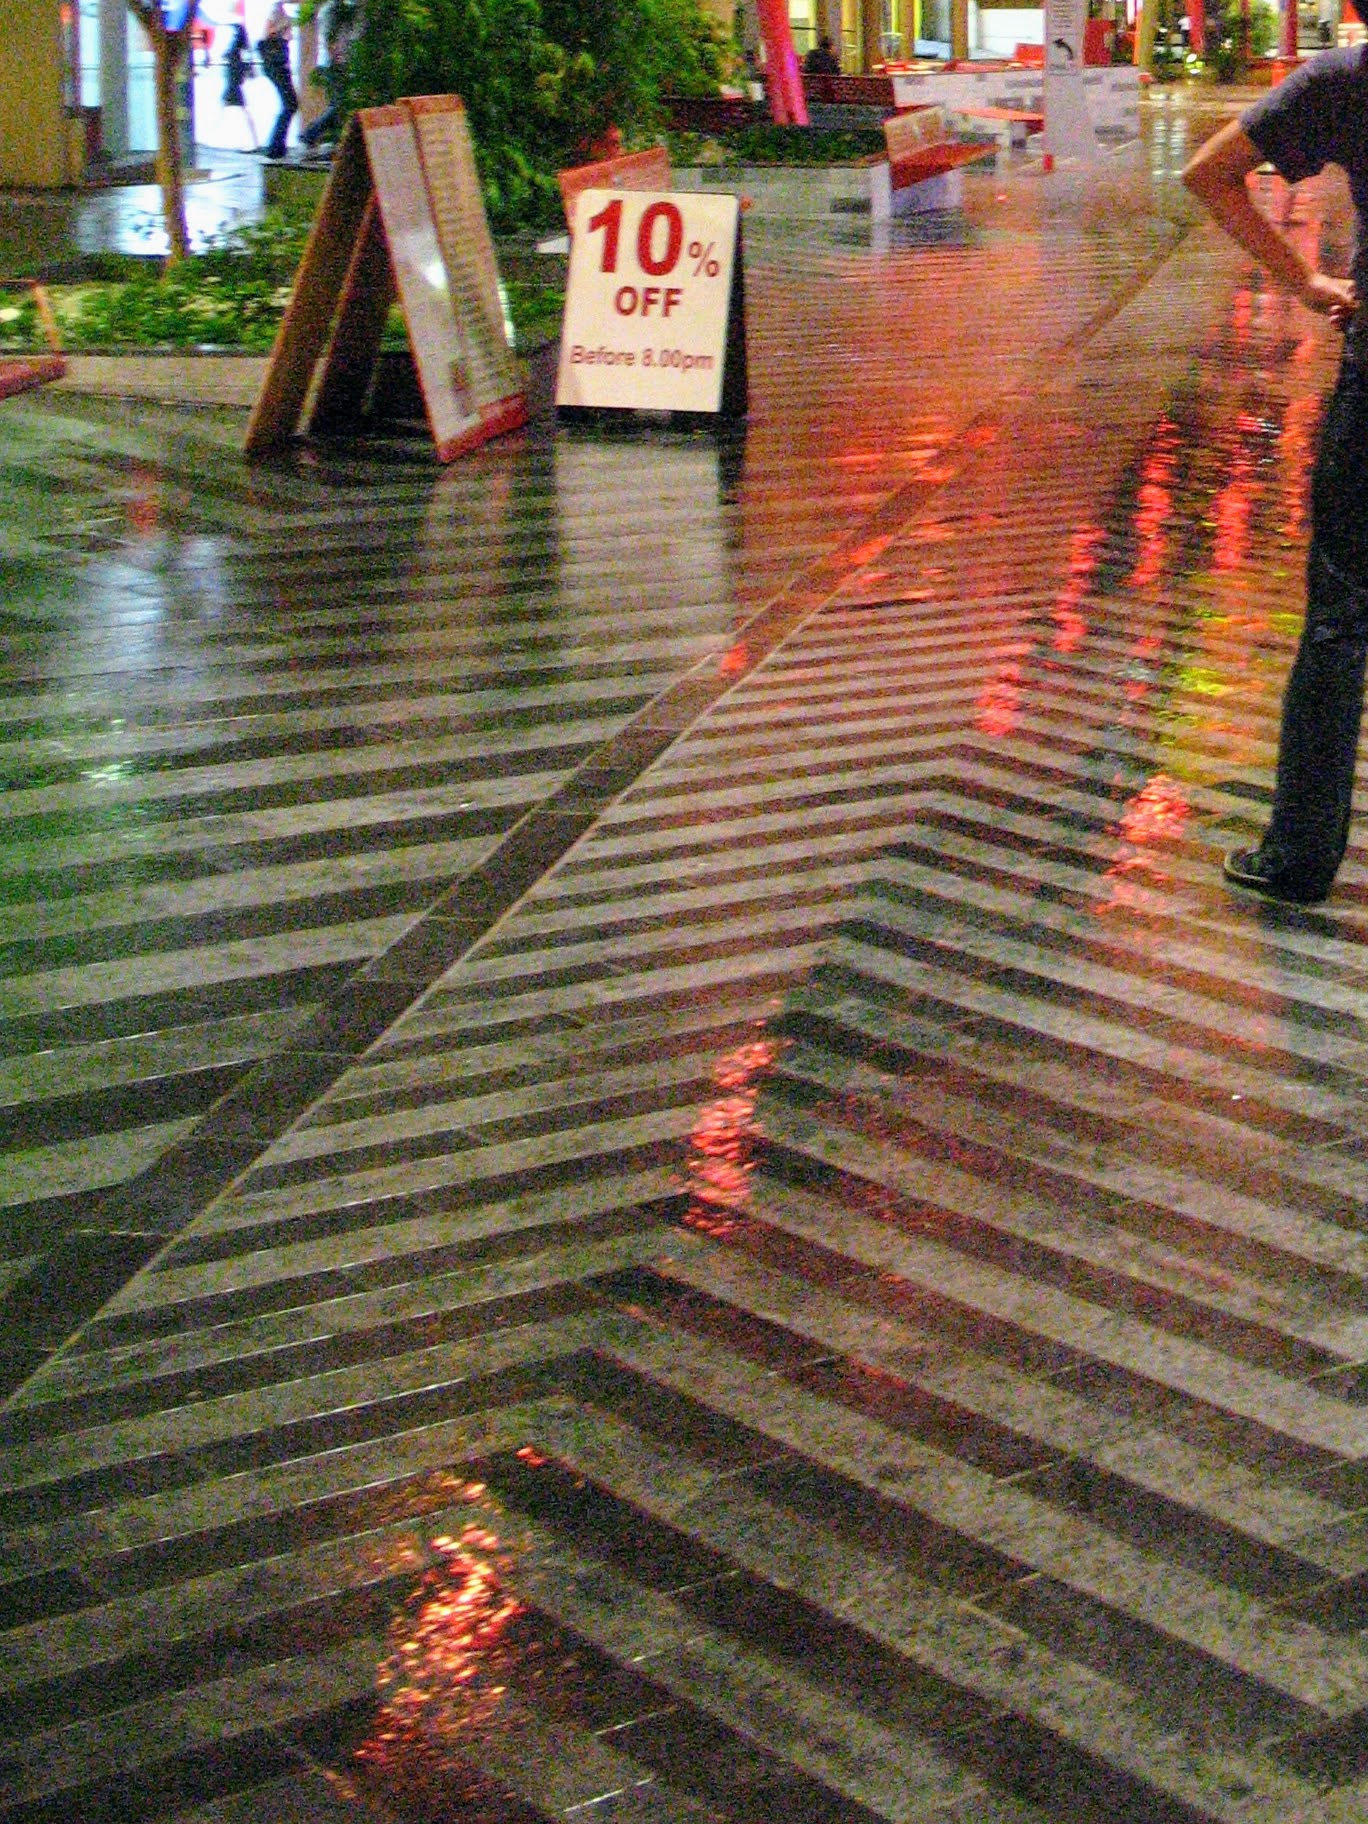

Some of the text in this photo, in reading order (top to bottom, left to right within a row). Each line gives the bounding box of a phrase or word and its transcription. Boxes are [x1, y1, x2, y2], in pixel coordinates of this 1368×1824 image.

[614, 285, 683, 318] OFF
[570, 345, 714, 372] Before 8.00pm
